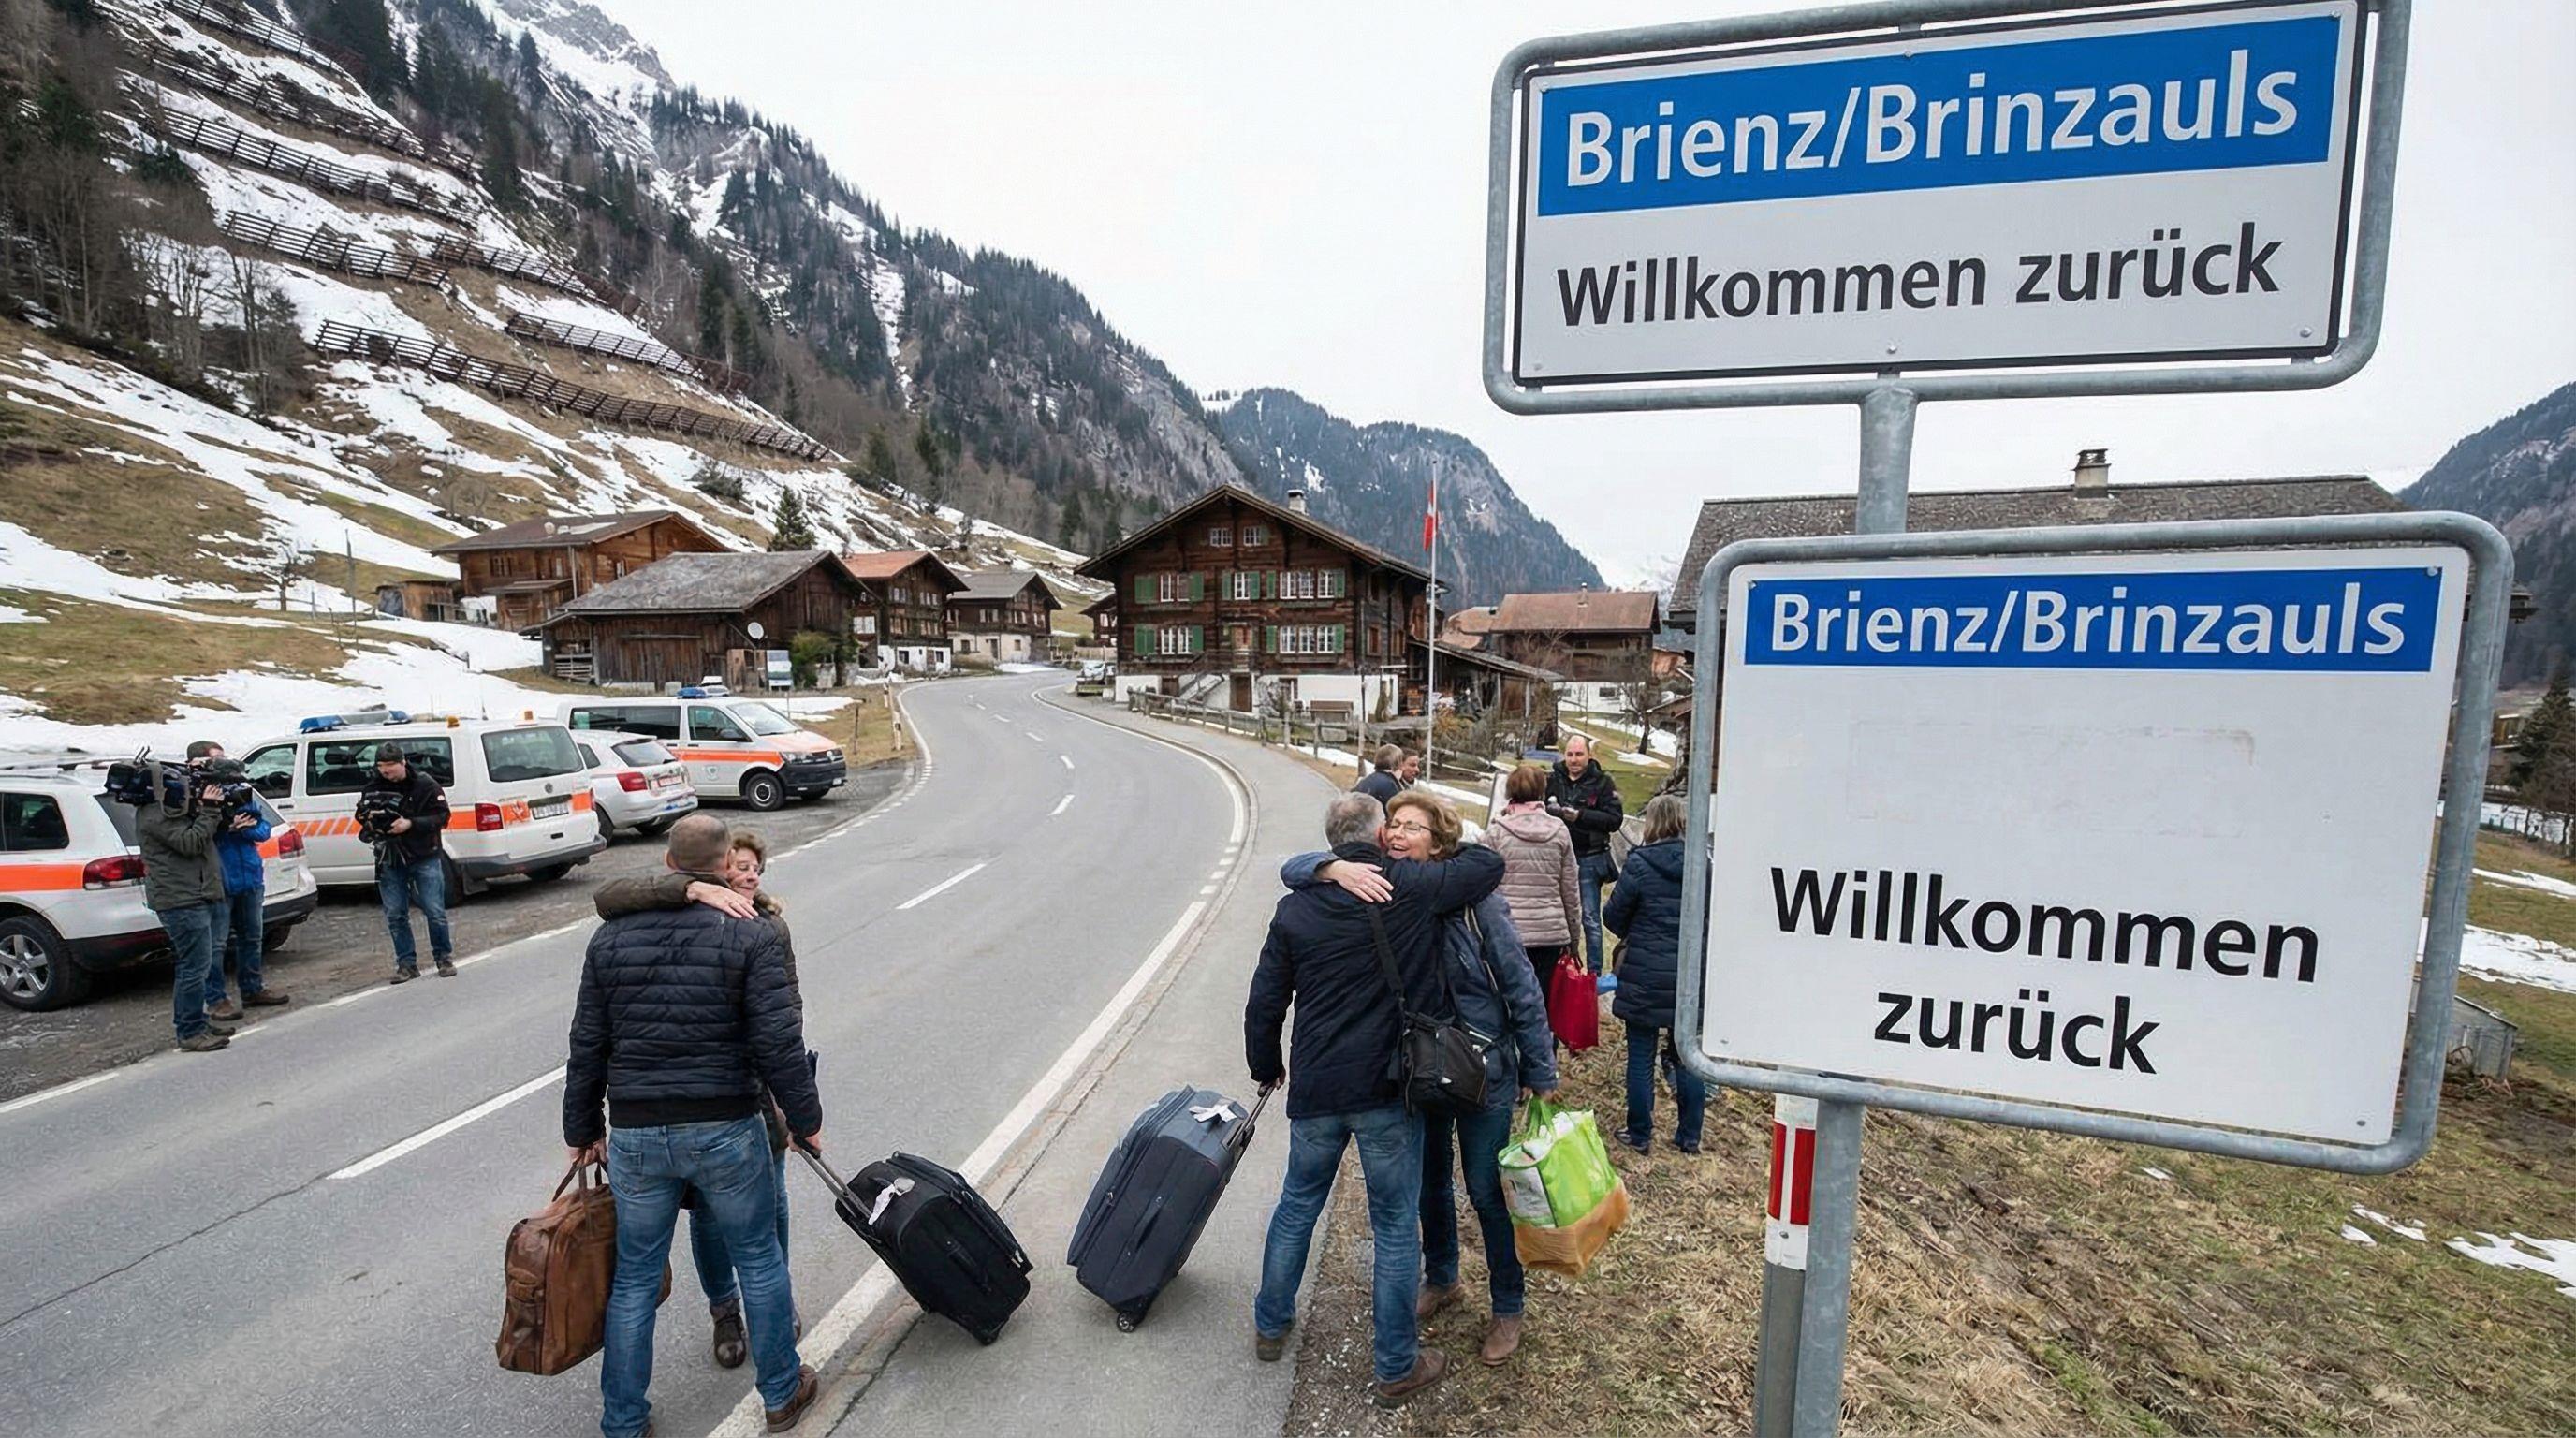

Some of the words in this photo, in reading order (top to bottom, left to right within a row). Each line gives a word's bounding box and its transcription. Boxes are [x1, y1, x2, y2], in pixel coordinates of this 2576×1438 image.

[1567, 49, 2298, 187] Brienz/Brinzauls
[1557, 256, 1987, 327] Willkommen
[2015, 221, 2283, 305] zurück
[1772, 582, 2405, 654] Brienz/Brinzauls
[1770, 867, 2319, 983] Willkommen
[1874, 988, 2160, 1075] zurück
